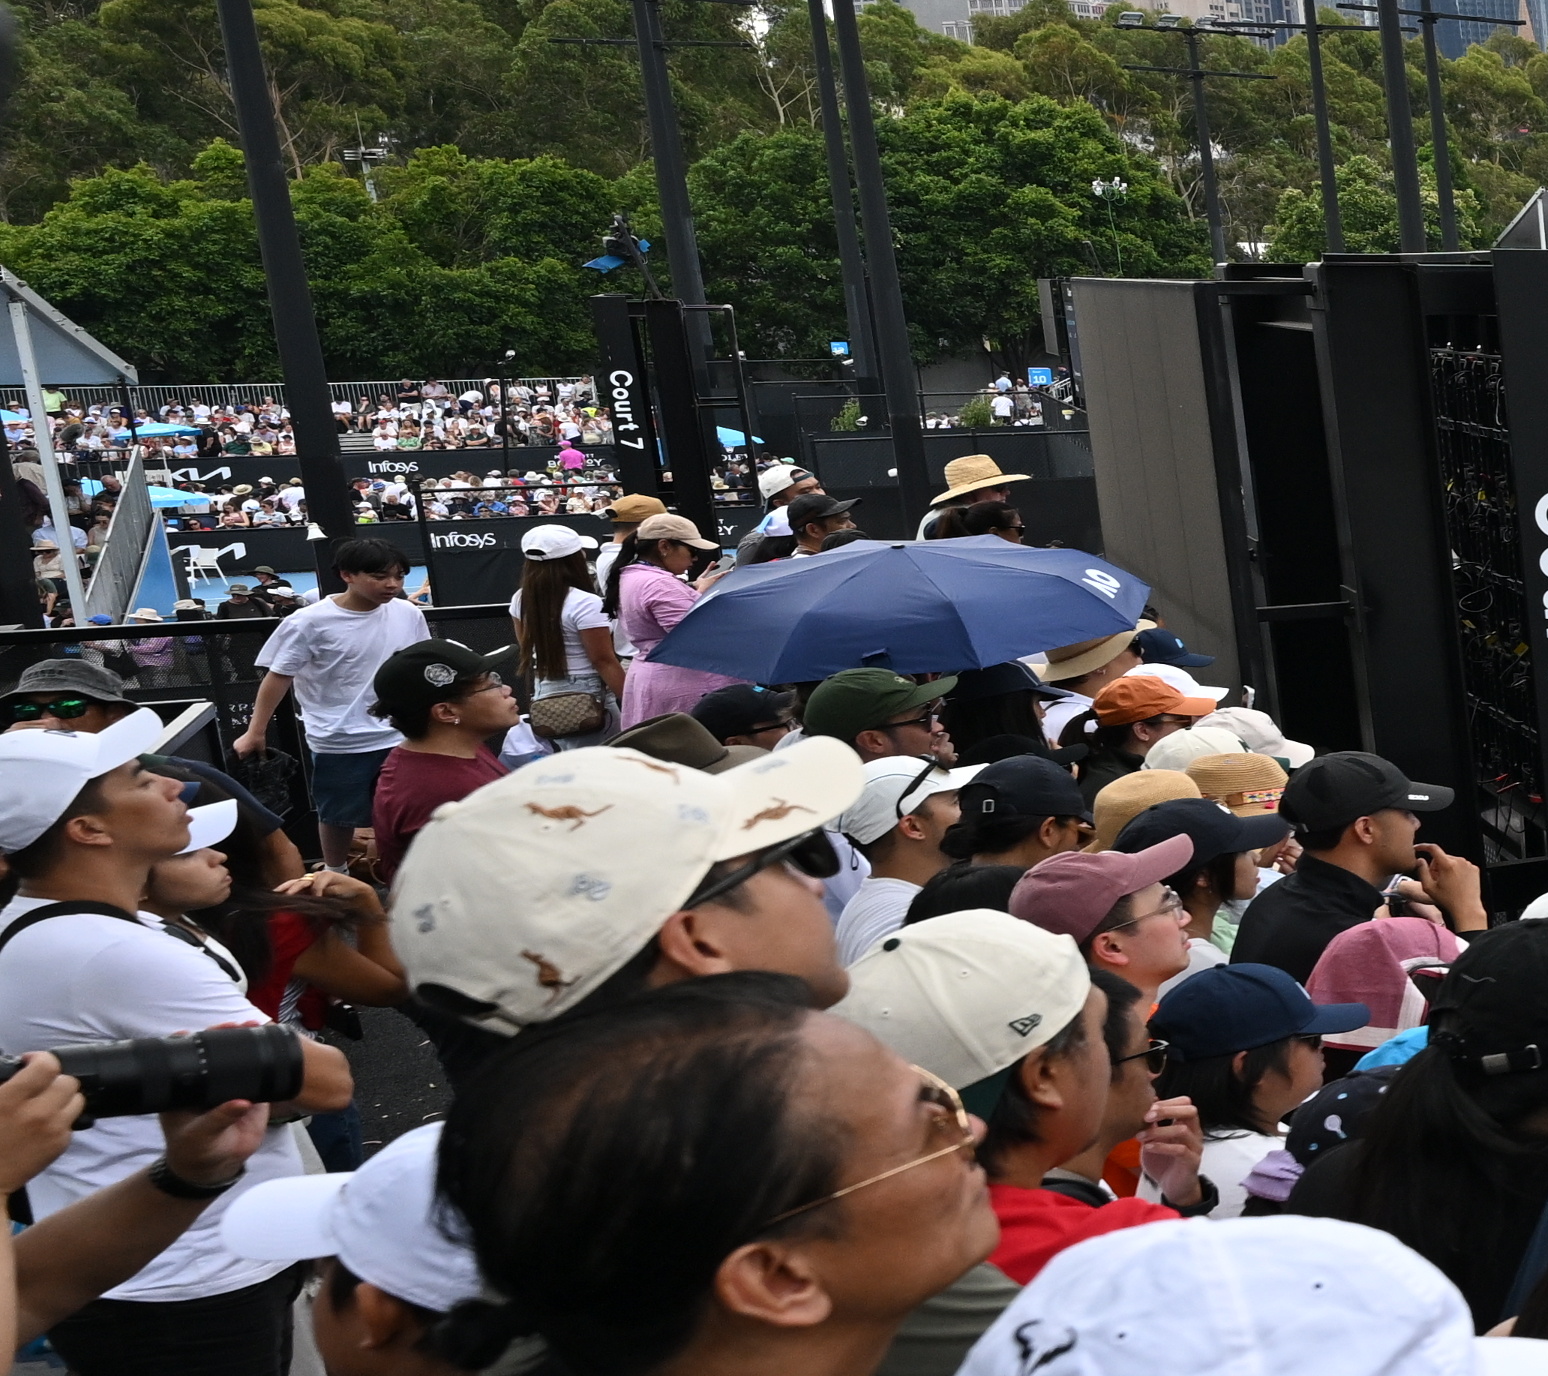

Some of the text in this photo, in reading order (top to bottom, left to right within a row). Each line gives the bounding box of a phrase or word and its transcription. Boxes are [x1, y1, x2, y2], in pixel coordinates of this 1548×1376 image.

[1033, 375, 1046, 384] 10
[609, 370, 644, 450] Court 7
[368, 460, 419, 474] Infosys
[430, 532, 496, 550] Infosys
